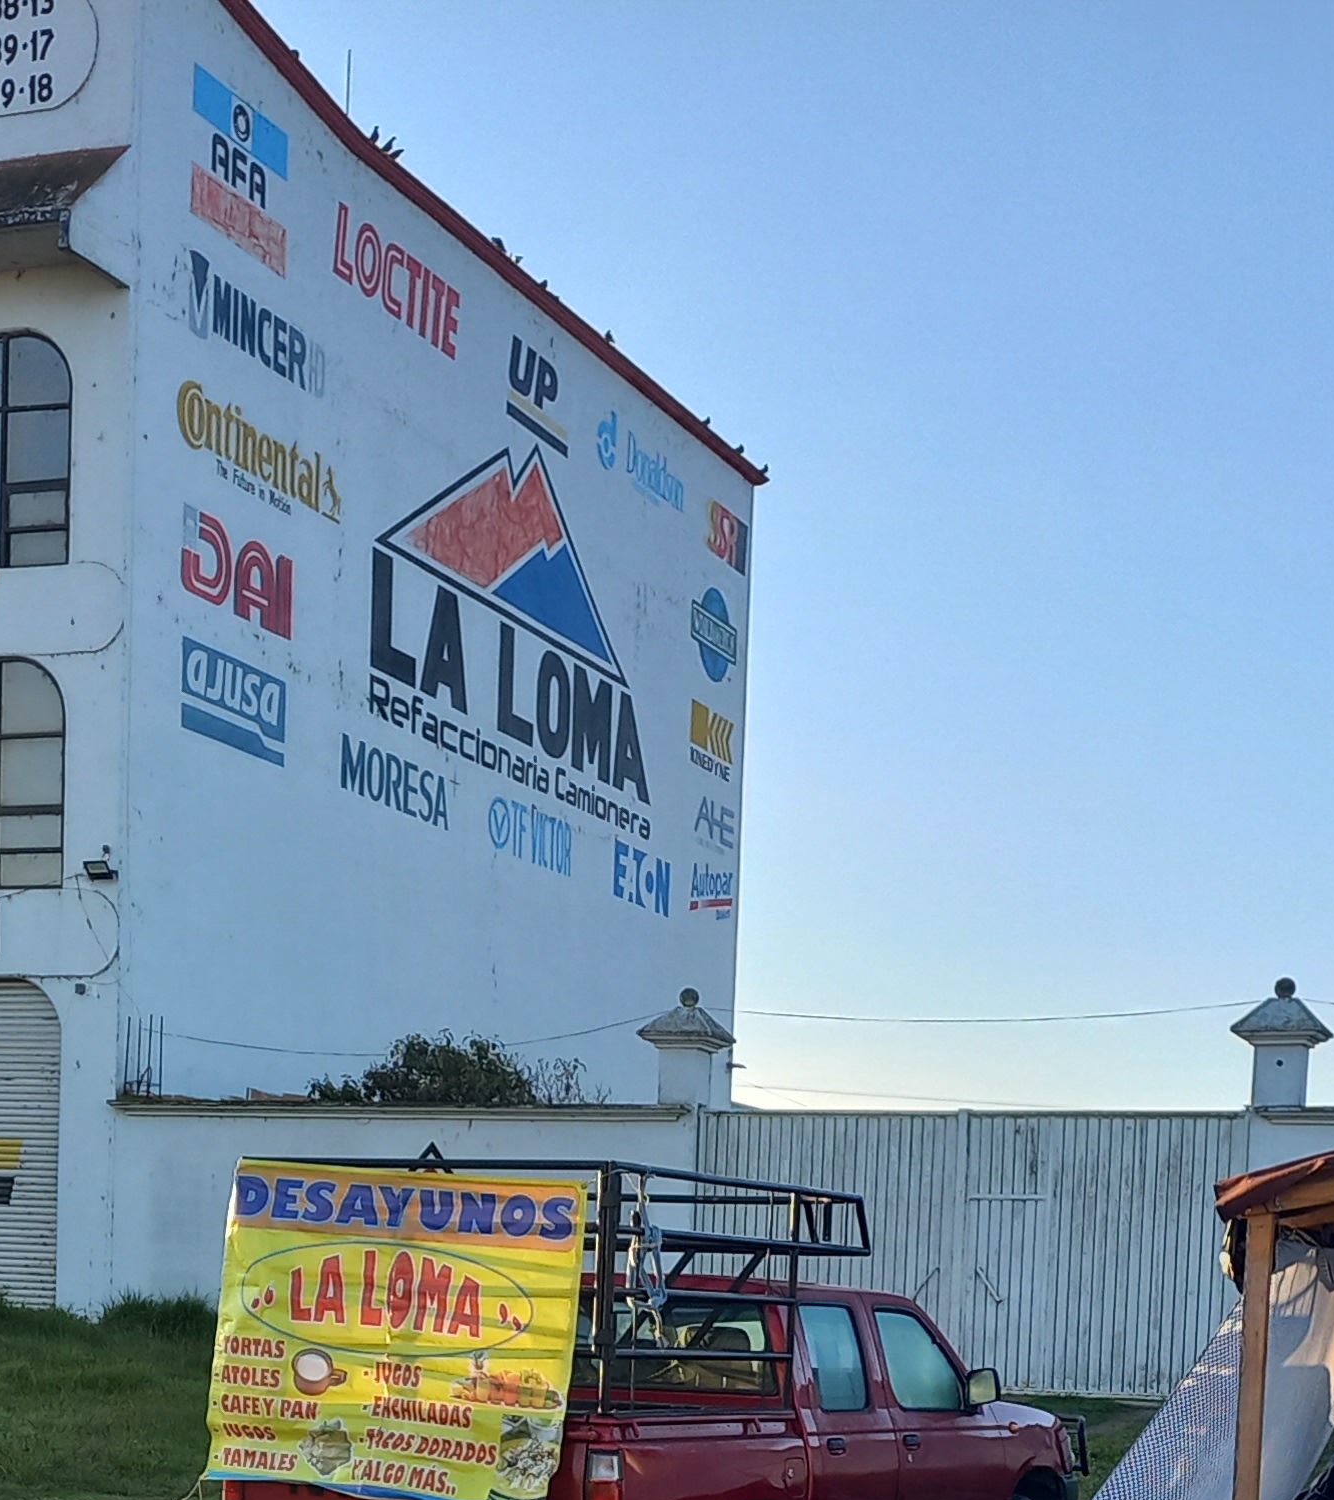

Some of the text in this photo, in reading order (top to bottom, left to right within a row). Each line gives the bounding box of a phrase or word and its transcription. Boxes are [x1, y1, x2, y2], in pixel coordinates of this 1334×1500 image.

[212, 133, 266, 209] AFA
[332, 201, 460, 360] LOCTITE
[212, 273, 306, 391] MINCER
[509, 334, 559, 410] UP
[177, 380, 322, 513] Continental
[180, 506, 293, 641] DAI
[370, 547, 651, 806] LA LOMA
[340, 733, 449, 831] MORESA
[368, 673, 651, 840] Refaccionaria Camionera
[530, 804, 572, 877] VICTOR
[691, 863, 733, 899] Autopar
[236, 1174, 575, 1240] DESAYUNOS
[290, 1249, 481, 1338] LA LOMA
[221, 1365, 280, 1388] ATOLES
[221, 1394, 261, 1415] CAFE
[280, 1399, 319, 1420] PAN
[374, 1362, 422, 1387] JUGOS
[371, 1396, 473, 1428] ENCHILADAS
[223, 1448, 298, 1472] TAMALES
[364, 1460, 406, 1484] ALGO
[415, 1436, 498, 1465] DORADOS
